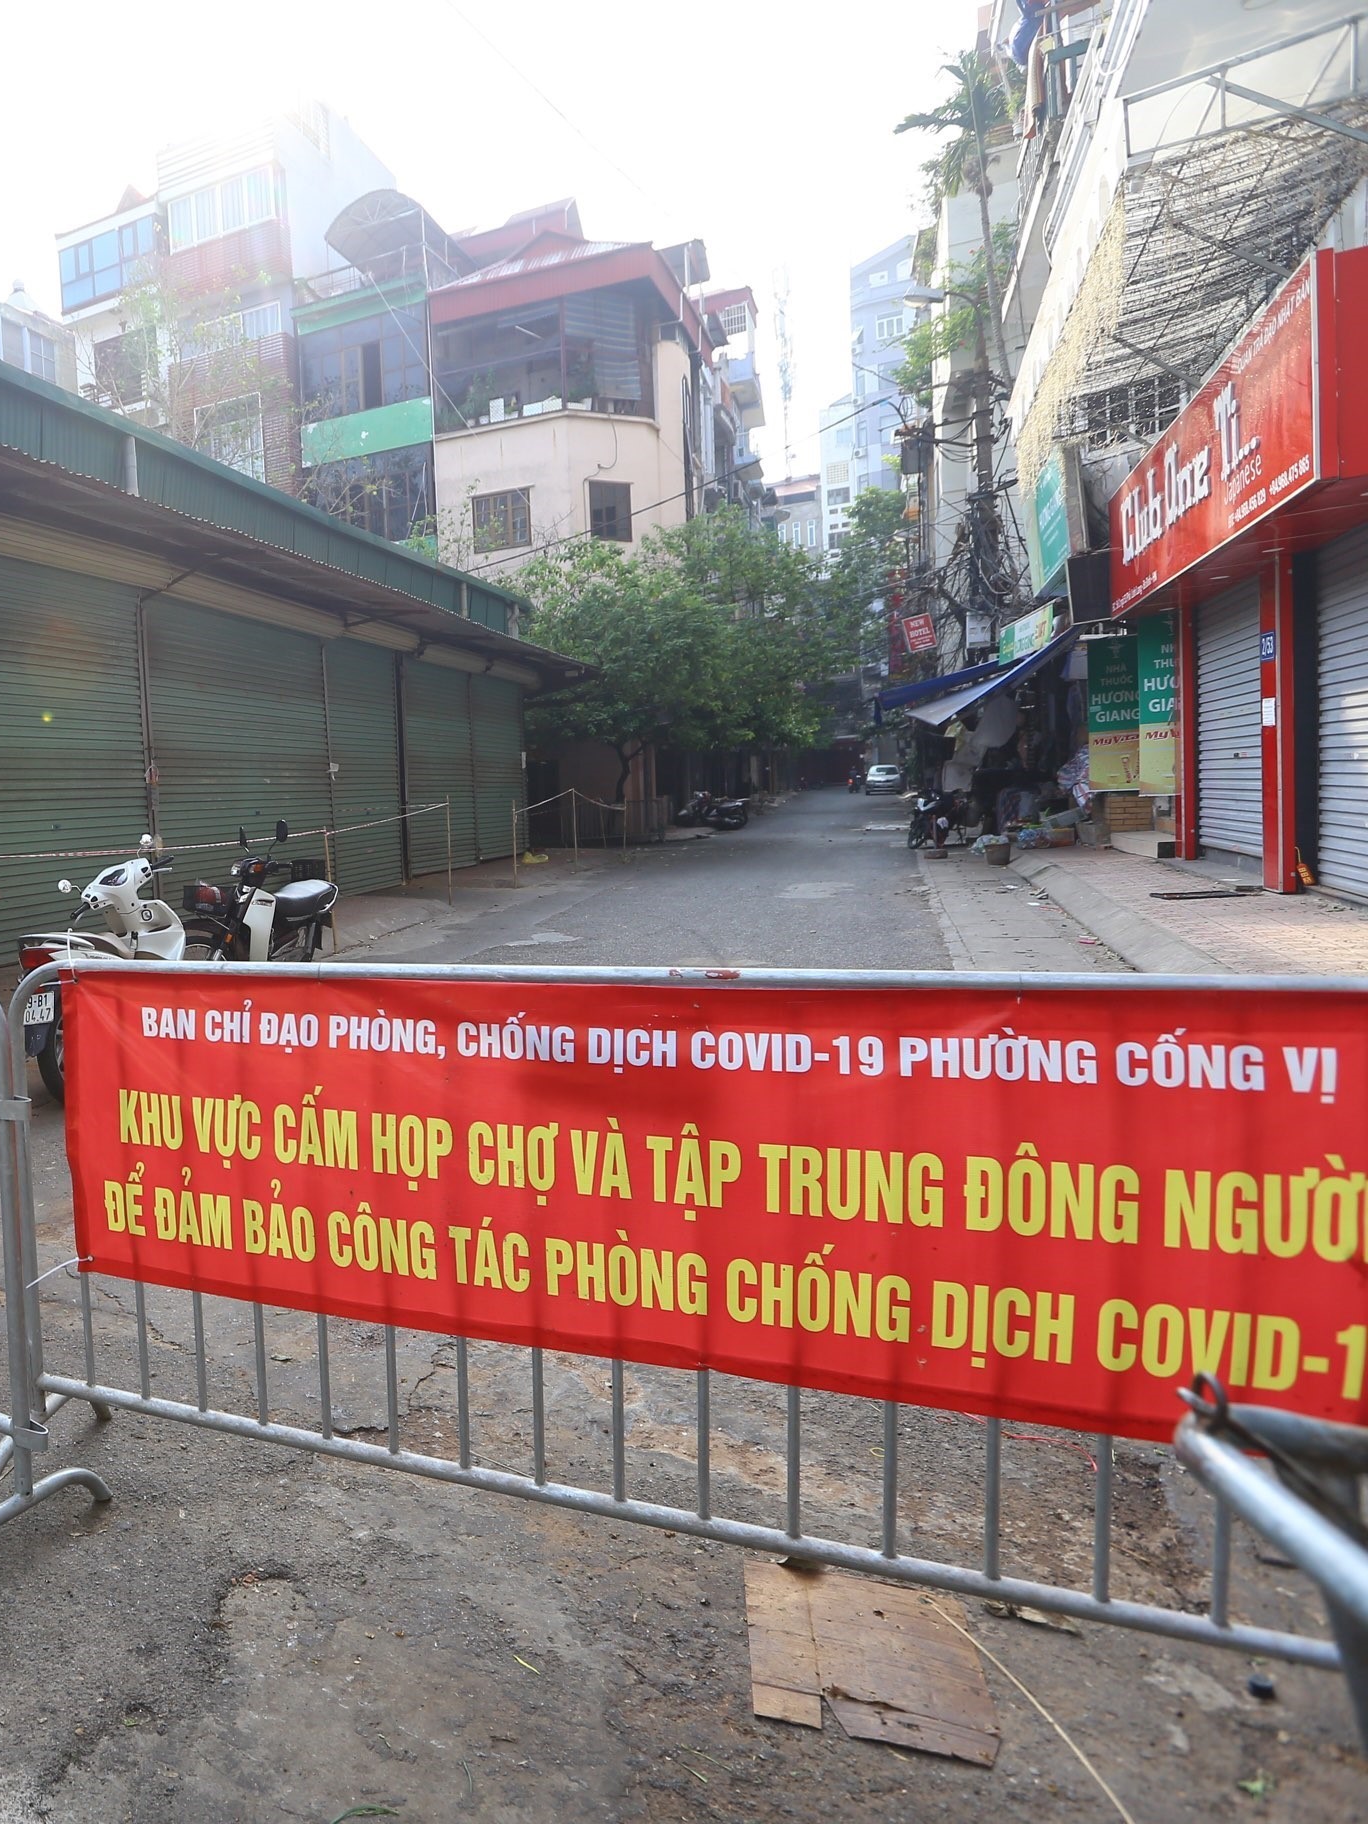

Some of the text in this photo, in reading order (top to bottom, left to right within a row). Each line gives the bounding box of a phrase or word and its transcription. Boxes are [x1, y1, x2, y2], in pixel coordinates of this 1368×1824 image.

[909, 618, 925, 628] NEW
[909, 627, 931, 639] HOTEL
[1261, 635, 1274, 657] 2/53
[25, 995, 48, 1009] 9-B1
[141, 999, 1337, 1104] BAN CHỈ ĐẠO PHÒNG, CHỐNG DỊCH COVID-19 PHƯỜNG CỐNG VỊ
[119, 1085, 1368, 1264] KHU VỰC CẤM HỌP CHỢ VÀ TẬP TRUNG ĐÔNG NGƯỜ
[104, 1161, 146, 1238] ĐỂ
[154, 1166, 233, 1250] ĐẢM
[244, 1179, 317, 1263] BẢO
[329, 1202, 437, 1281] CÔNG
[448, 1217, 531, 1293] TÁC
[546, 1229, 708, 1316] PHÒNG
[726, 1243, 911, 1343] CHỐNG
[931, 1280, 1076, 1369] DỊCH
